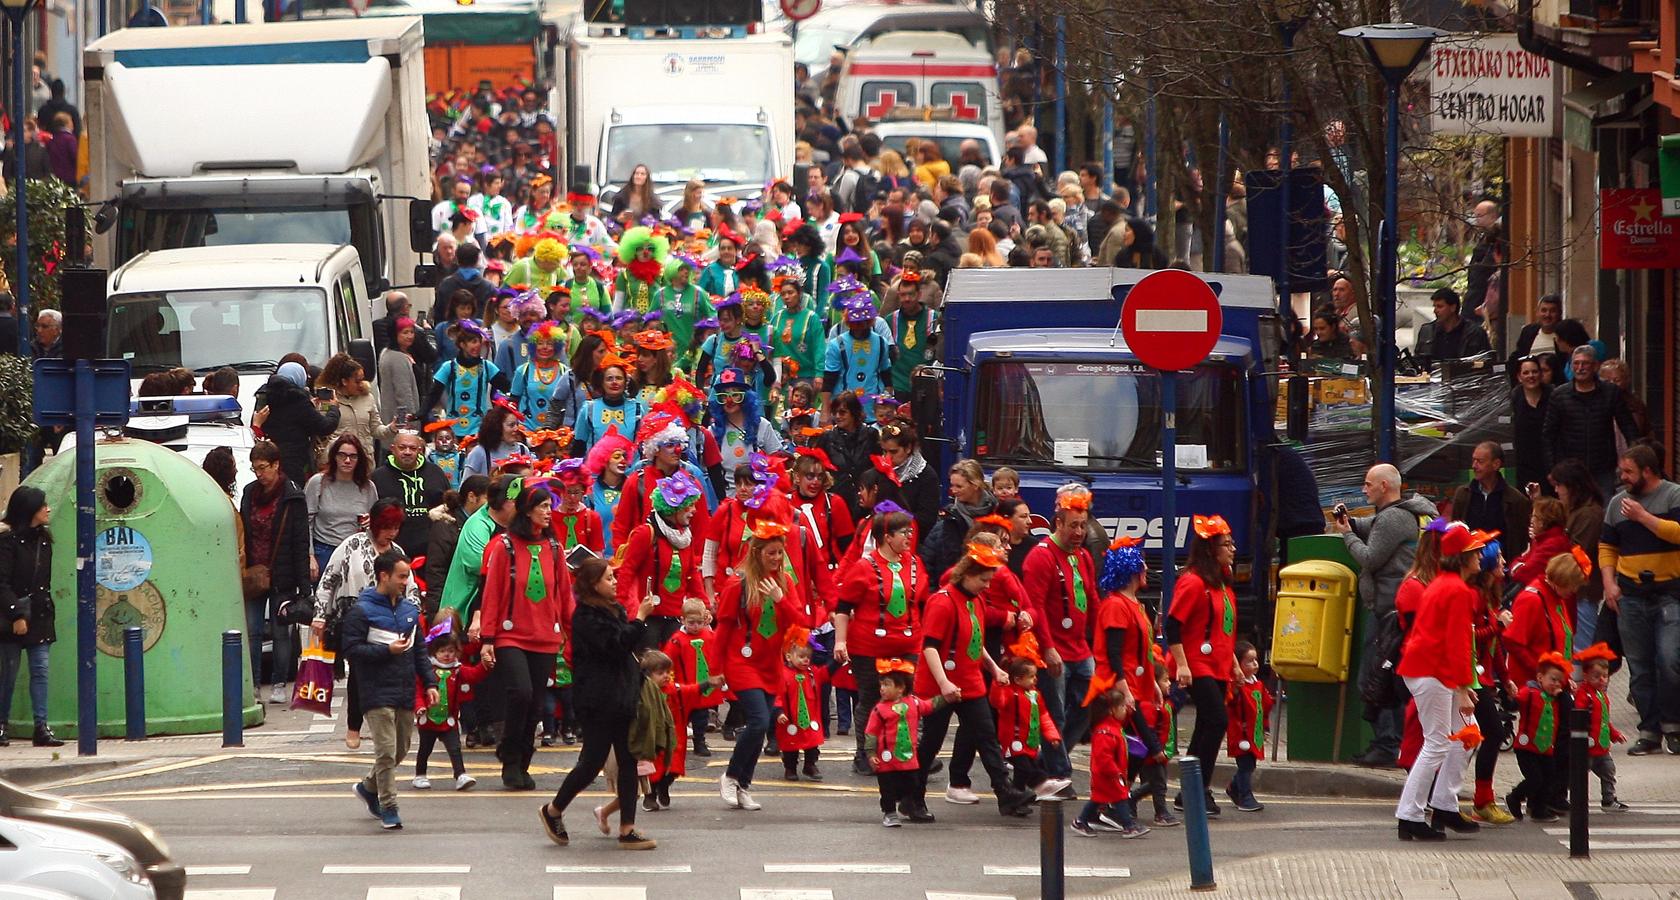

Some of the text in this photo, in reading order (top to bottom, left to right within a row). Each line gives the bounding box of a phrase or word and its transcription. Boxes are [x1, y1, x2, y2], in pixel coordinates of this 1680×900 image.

[1436, 48, 1551, 78] ETXERAKO DENDA
[1440, 92, 1545, 122] CENTRO HOGAR
[1613, 219, 1673, 235] Estrella
[1076, 365, 1102, 373] Garage
[105, 528, 135, 546] BAI
[1095, 517, 1190, 548] EPSI
